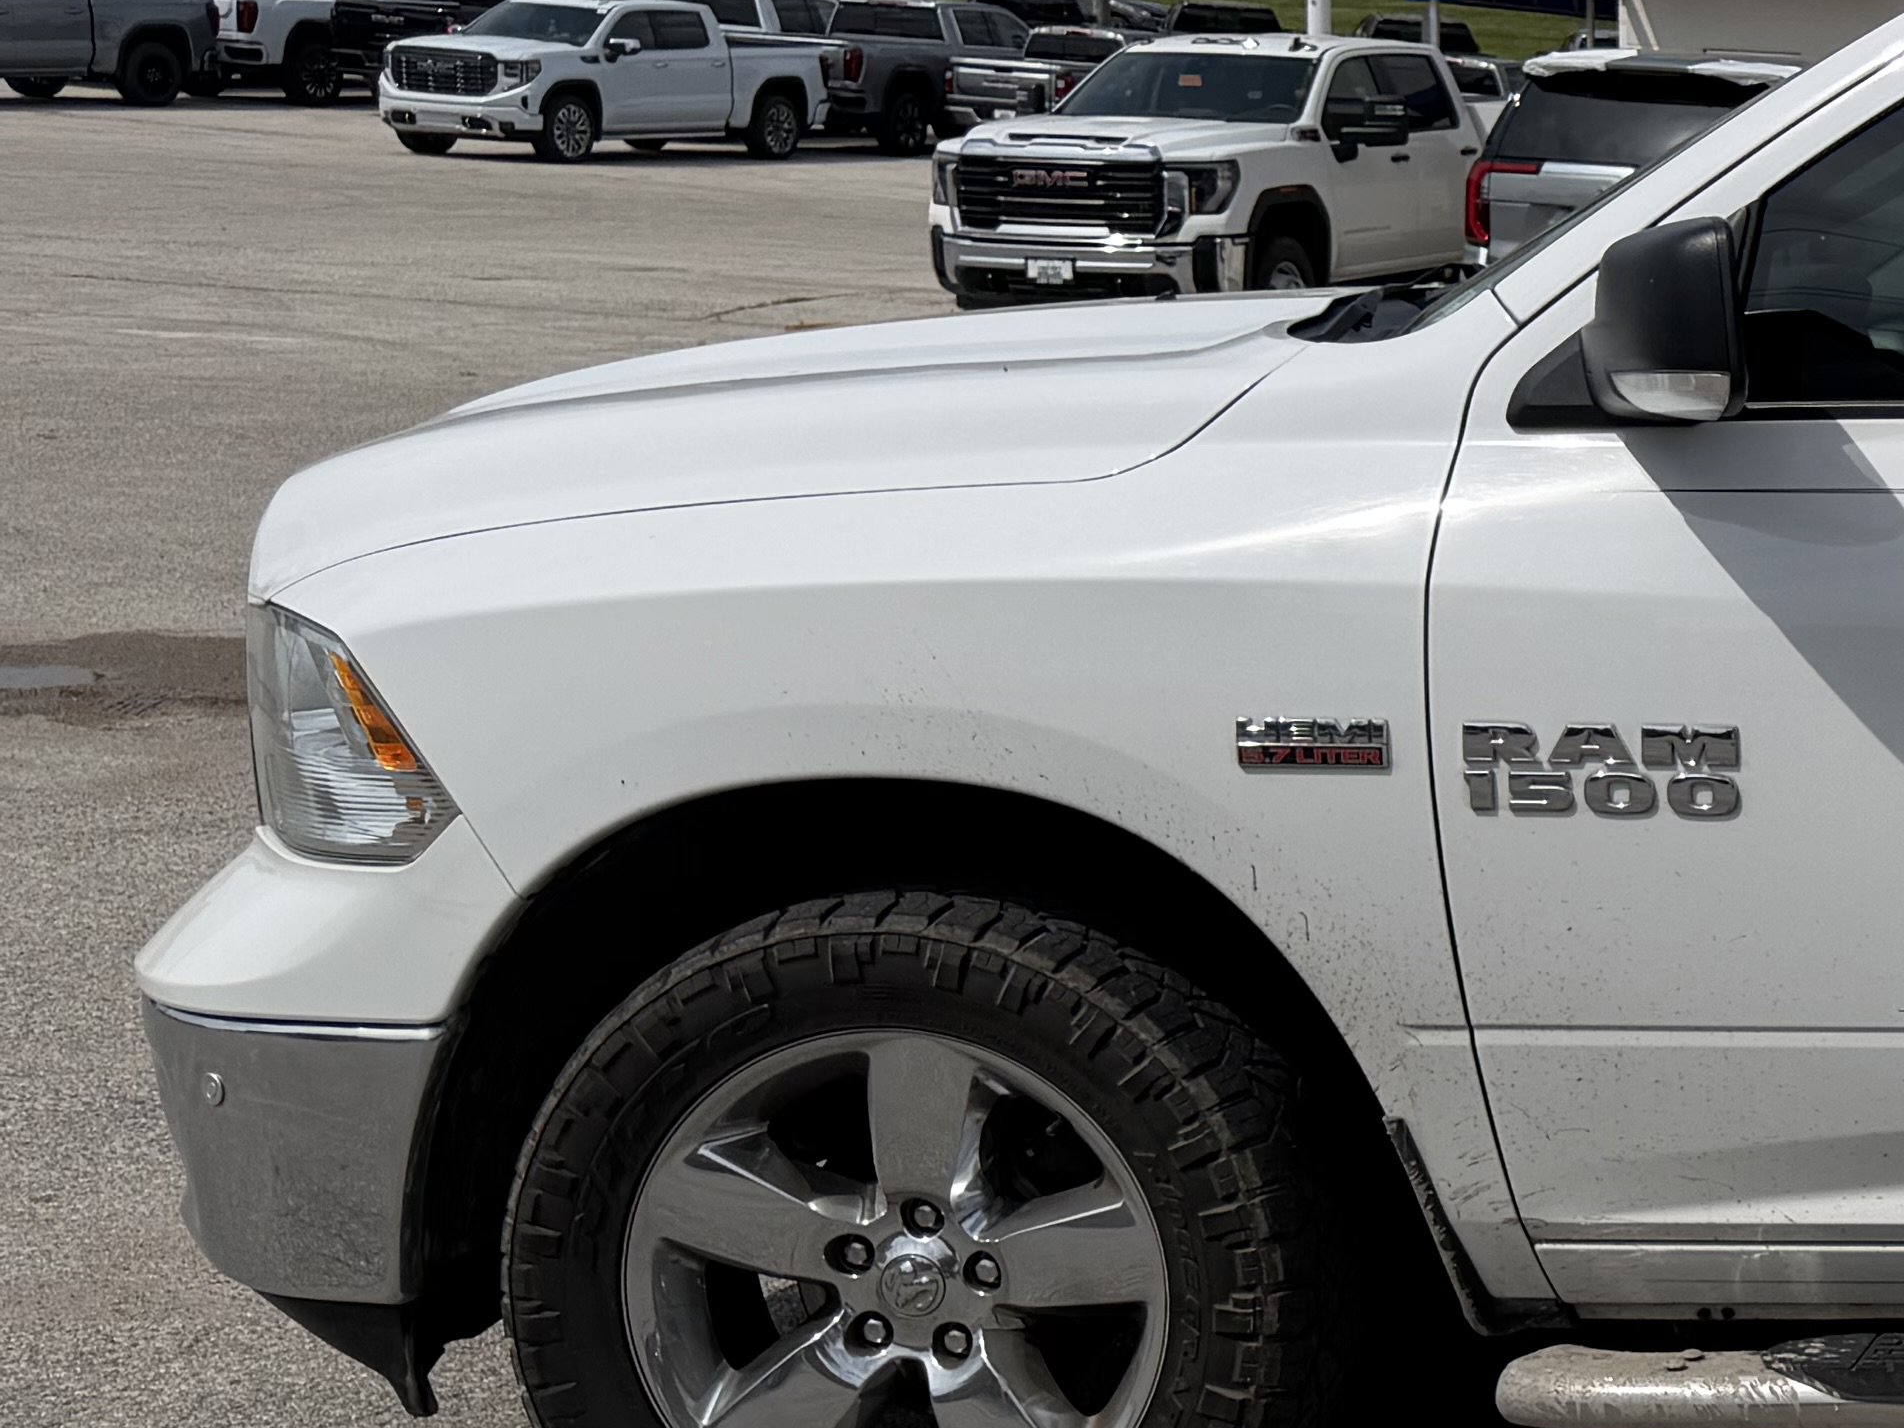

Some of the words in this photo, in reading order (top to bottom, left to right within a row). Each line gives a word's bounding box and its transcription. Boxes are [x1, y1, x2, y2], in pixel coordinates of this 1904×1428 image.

[1012, 169, 1089, 189] GMC
[1236, 716, 1388, 745] HEMI
[1240, 748, 1290, 765] 5.7
[1295, 749, 1380, 765] LITER
[1462, 721, 1740, 770] RAM
[1463, 769, 1740, 817] 1500
